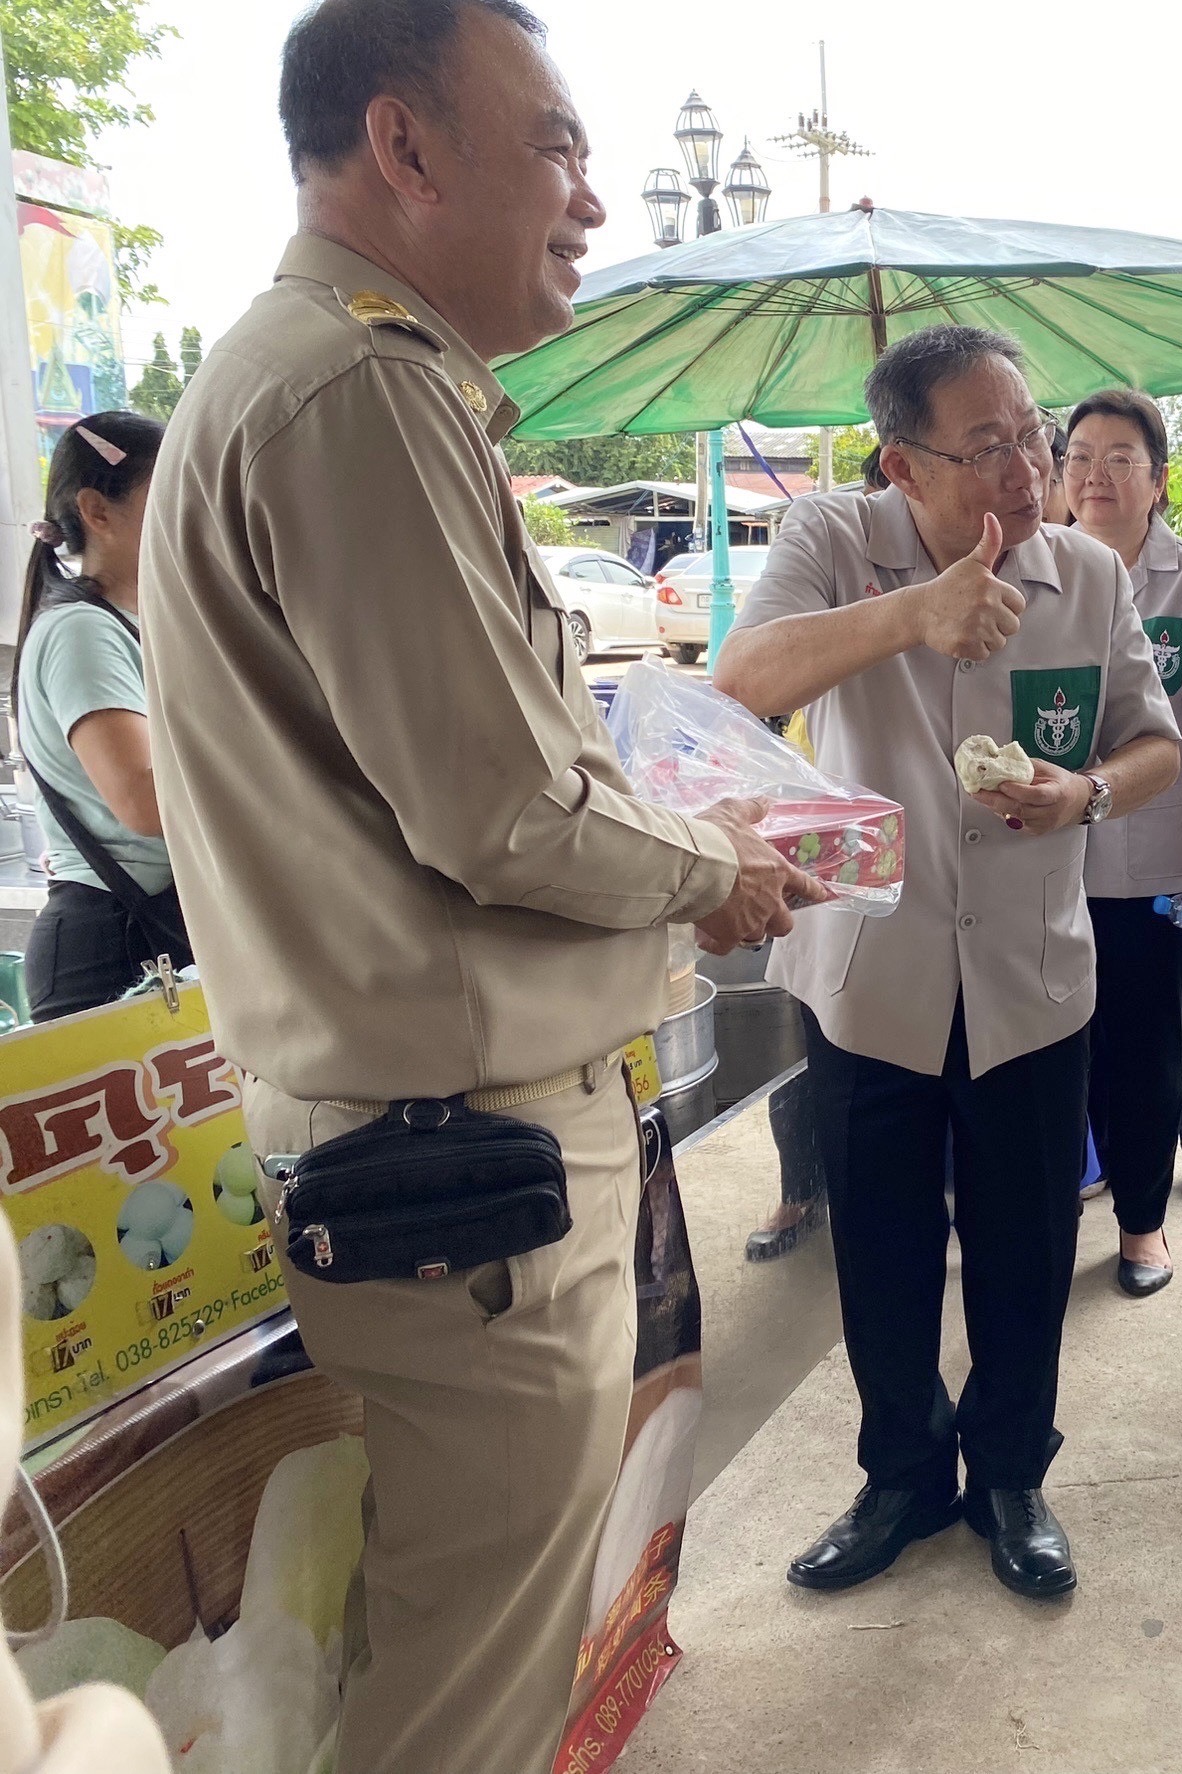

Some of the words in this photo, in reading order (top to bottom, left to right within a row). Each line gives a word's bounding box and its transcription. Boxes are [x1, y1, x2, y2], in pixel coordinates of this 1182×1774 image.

[152, 1294, 173, 1321] 17
[52, 1343, 74, 1373] 17
[72, 1337, 93, 1354] บาท
[77, 1360, 110, 1392] Tel.
